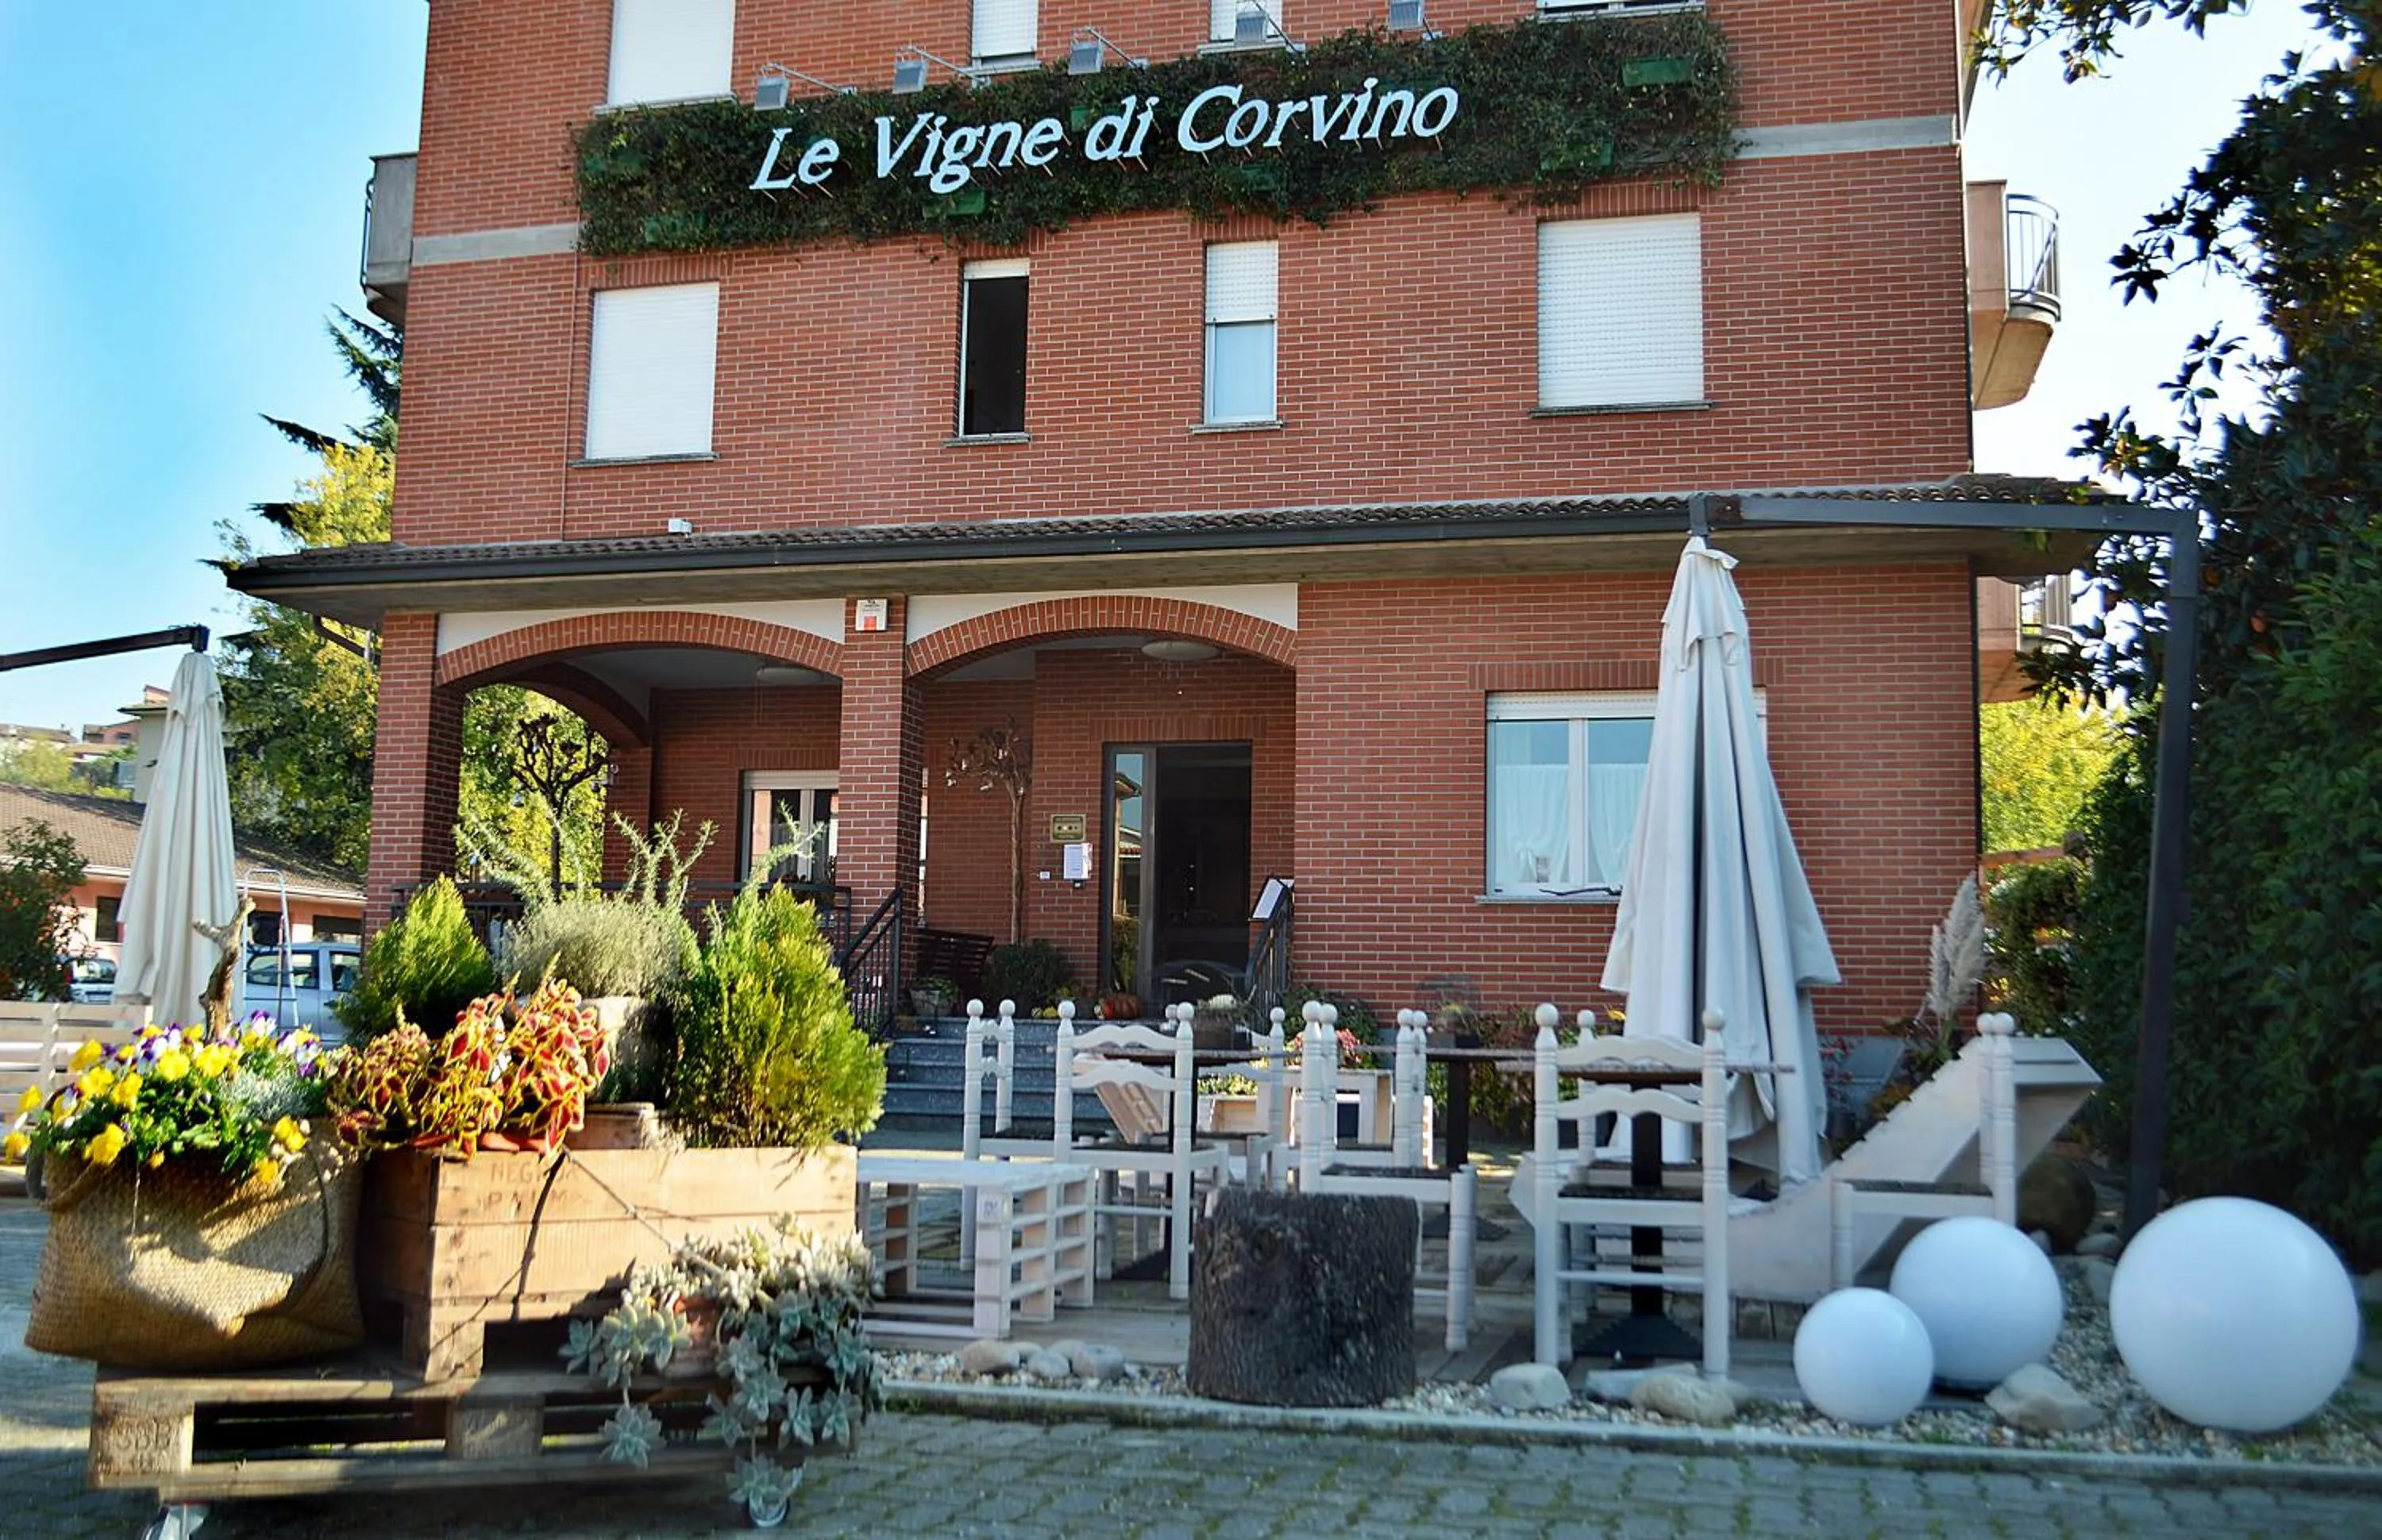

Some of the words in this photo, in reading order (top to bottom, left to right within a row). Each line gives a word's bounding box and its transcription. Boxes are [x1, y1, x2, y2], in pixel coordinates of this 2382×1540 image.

[749, 128, 839, 190] Le
[875, 112, 1063, 194] Vigne
[1085, 95, 1159, 160] di
[1178, 78, 1459, 152] Corvino
